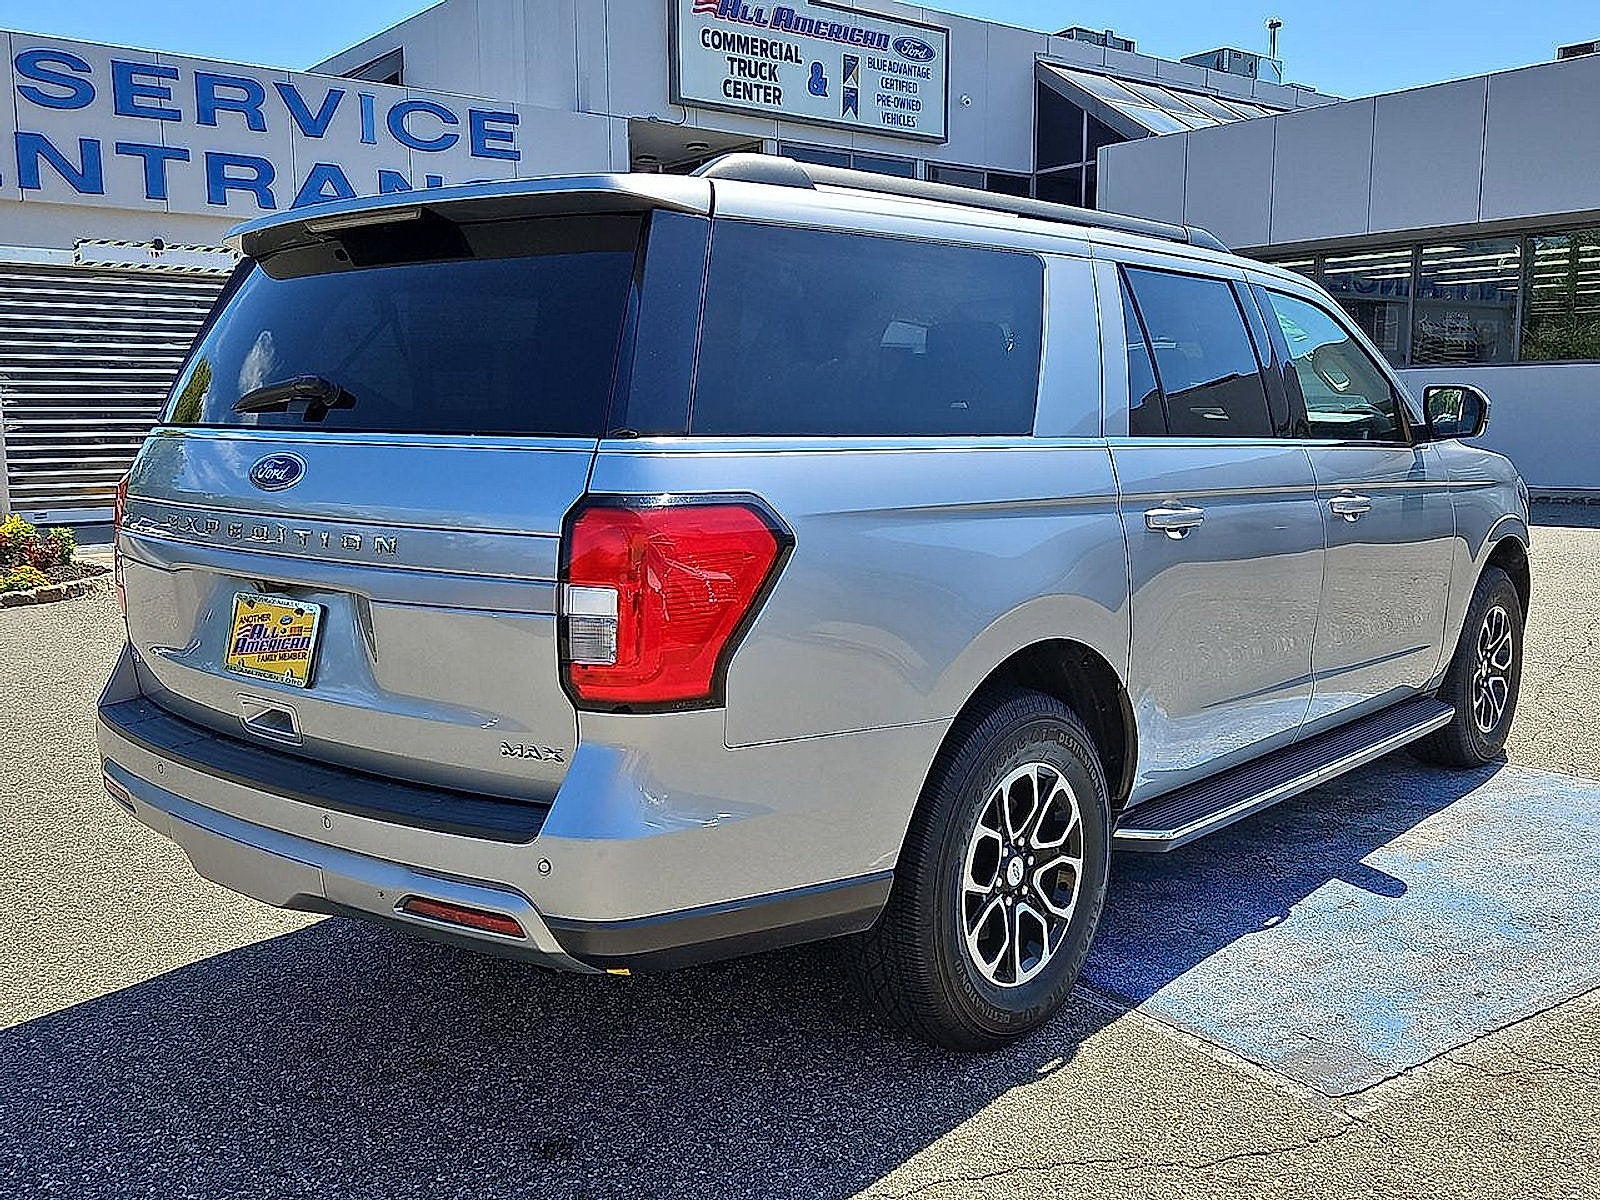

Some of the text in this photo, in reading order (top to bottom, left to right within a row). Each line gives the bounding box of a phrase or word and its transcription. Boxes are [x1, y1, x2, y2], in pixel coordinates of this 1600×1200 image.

[770, 7, 890, 51] AMERICAN
[701, 29, 803, 64] COMMERCIAL
[727, 57, 778, 82] TRUCK
[808, 61, 829, 97] &
[723, 79, 783, 106] CENTER
[880, 77, 918, 94] CERTIFIED
[14, 48, 522, 161] SERVICE
[876, 94, 922, 112] PRE-OWNED
[881, 111, 917, 128] VEHICLES
[0, 130, 490, 211] NTRA
[166, 513, 398, 555] EXPEDITION
[239, 613, 272, 624] ANOTHER
[249, 624, 279, 639] ALL
[232, 637, 312, 654] AMERICAN
[257, 651, 307, 663] FAMILY MEMBER
[500, 740, 565, 764] MAX
